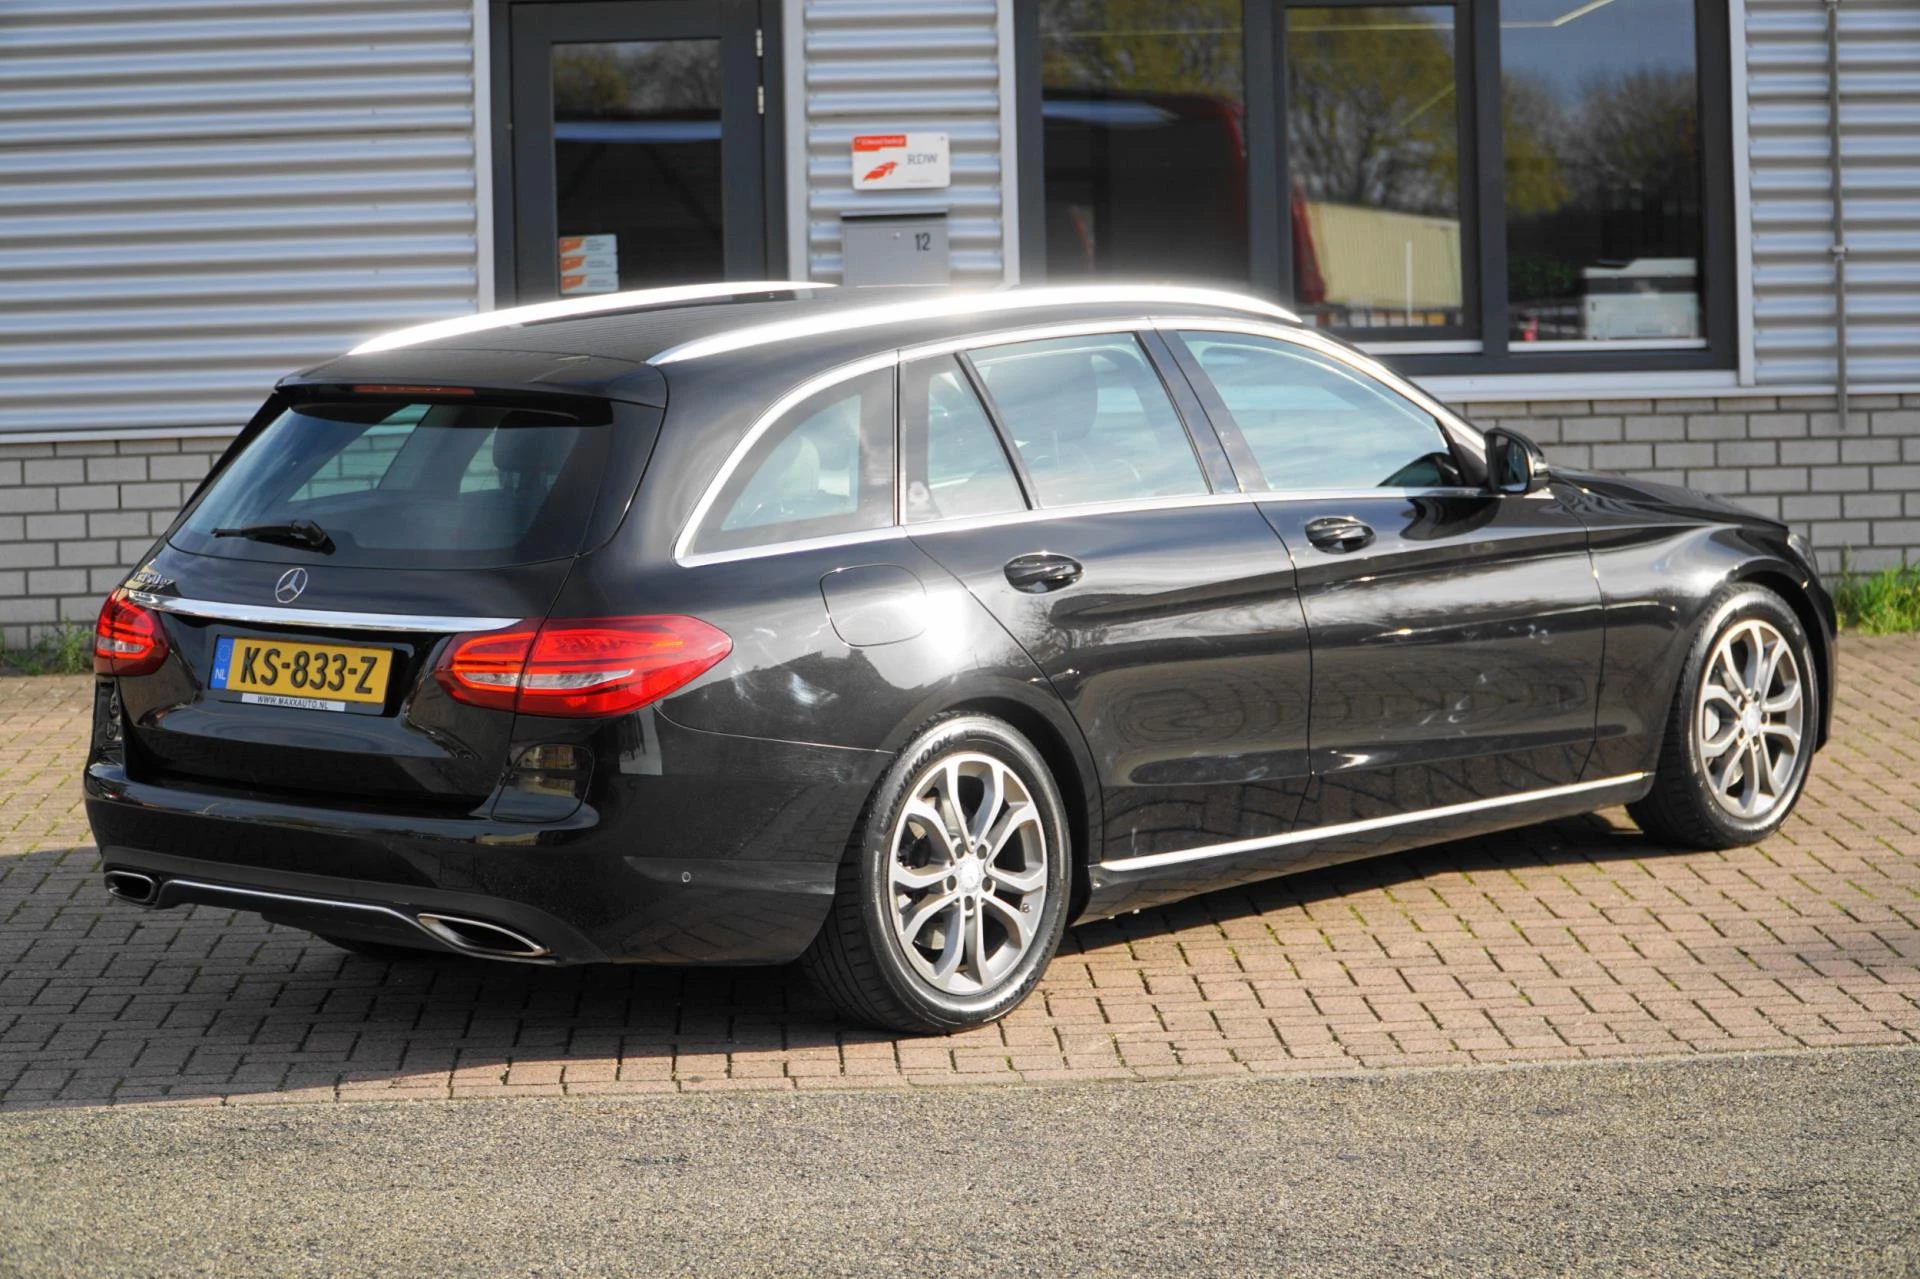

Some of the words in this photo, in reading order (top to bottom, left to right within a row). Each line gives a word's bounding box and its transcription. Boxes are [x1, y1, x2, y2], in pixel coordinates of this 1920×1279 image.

[914, 232, 931, 252] 12
[214, 668, 226, 681] NL
[239, 646, 378, 694] KS-833-Z
[257, 695, 329, 710] WWW.MAXXAUTO.NL
